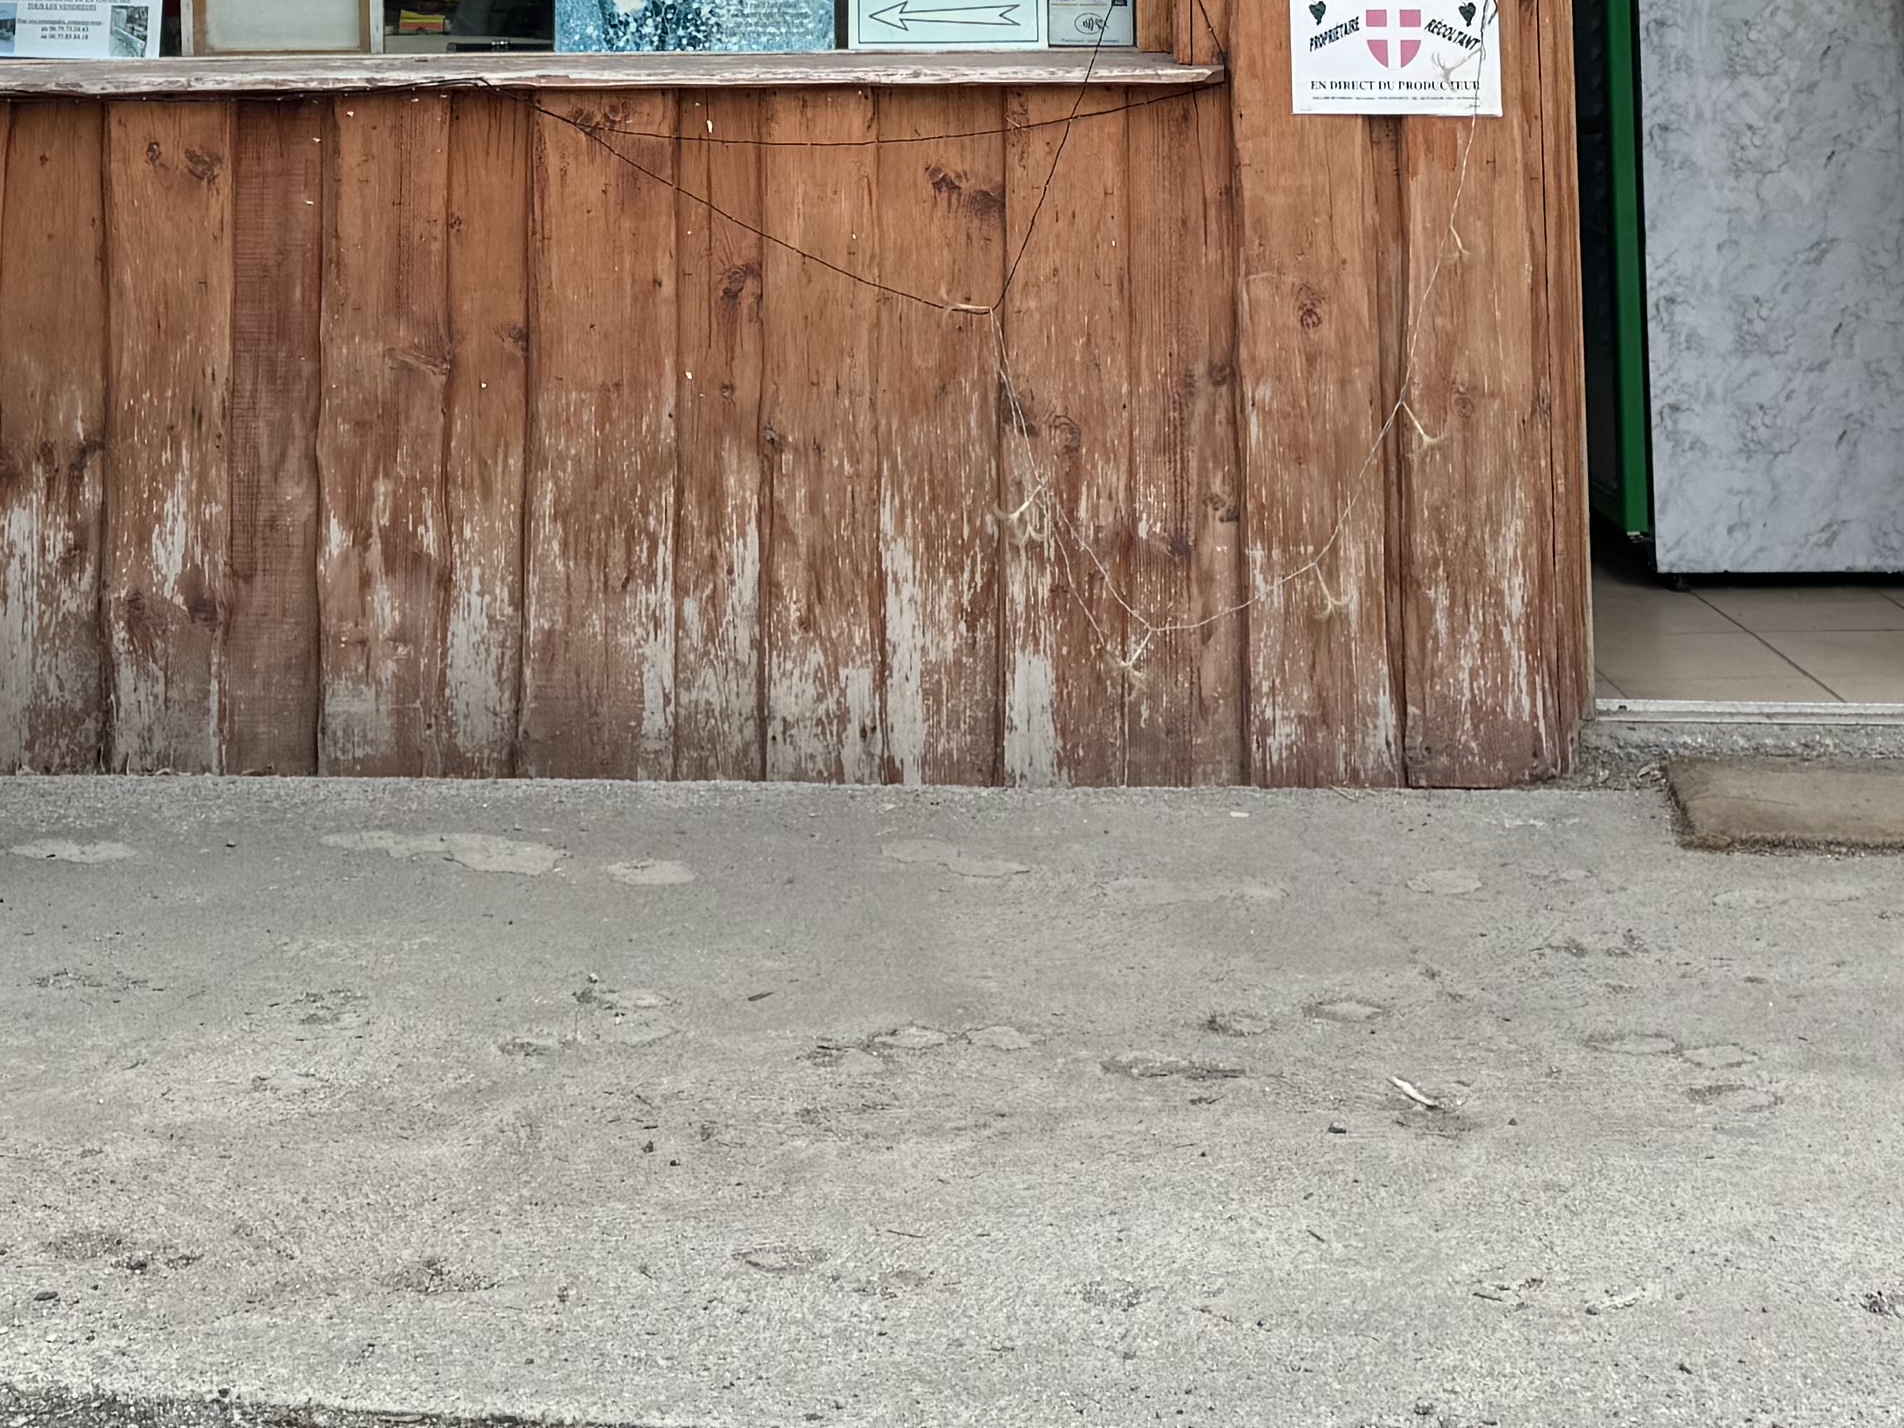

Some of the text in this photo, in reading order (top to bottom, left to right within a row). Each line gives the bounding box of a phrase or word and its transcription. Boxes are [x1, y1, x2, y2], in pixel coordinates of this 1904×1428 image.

[1424, 18, 1481, 51] RÉCOLTANT
[1310, 80, 1480, 91] EN DIRECT DU PRODUCTEUR
